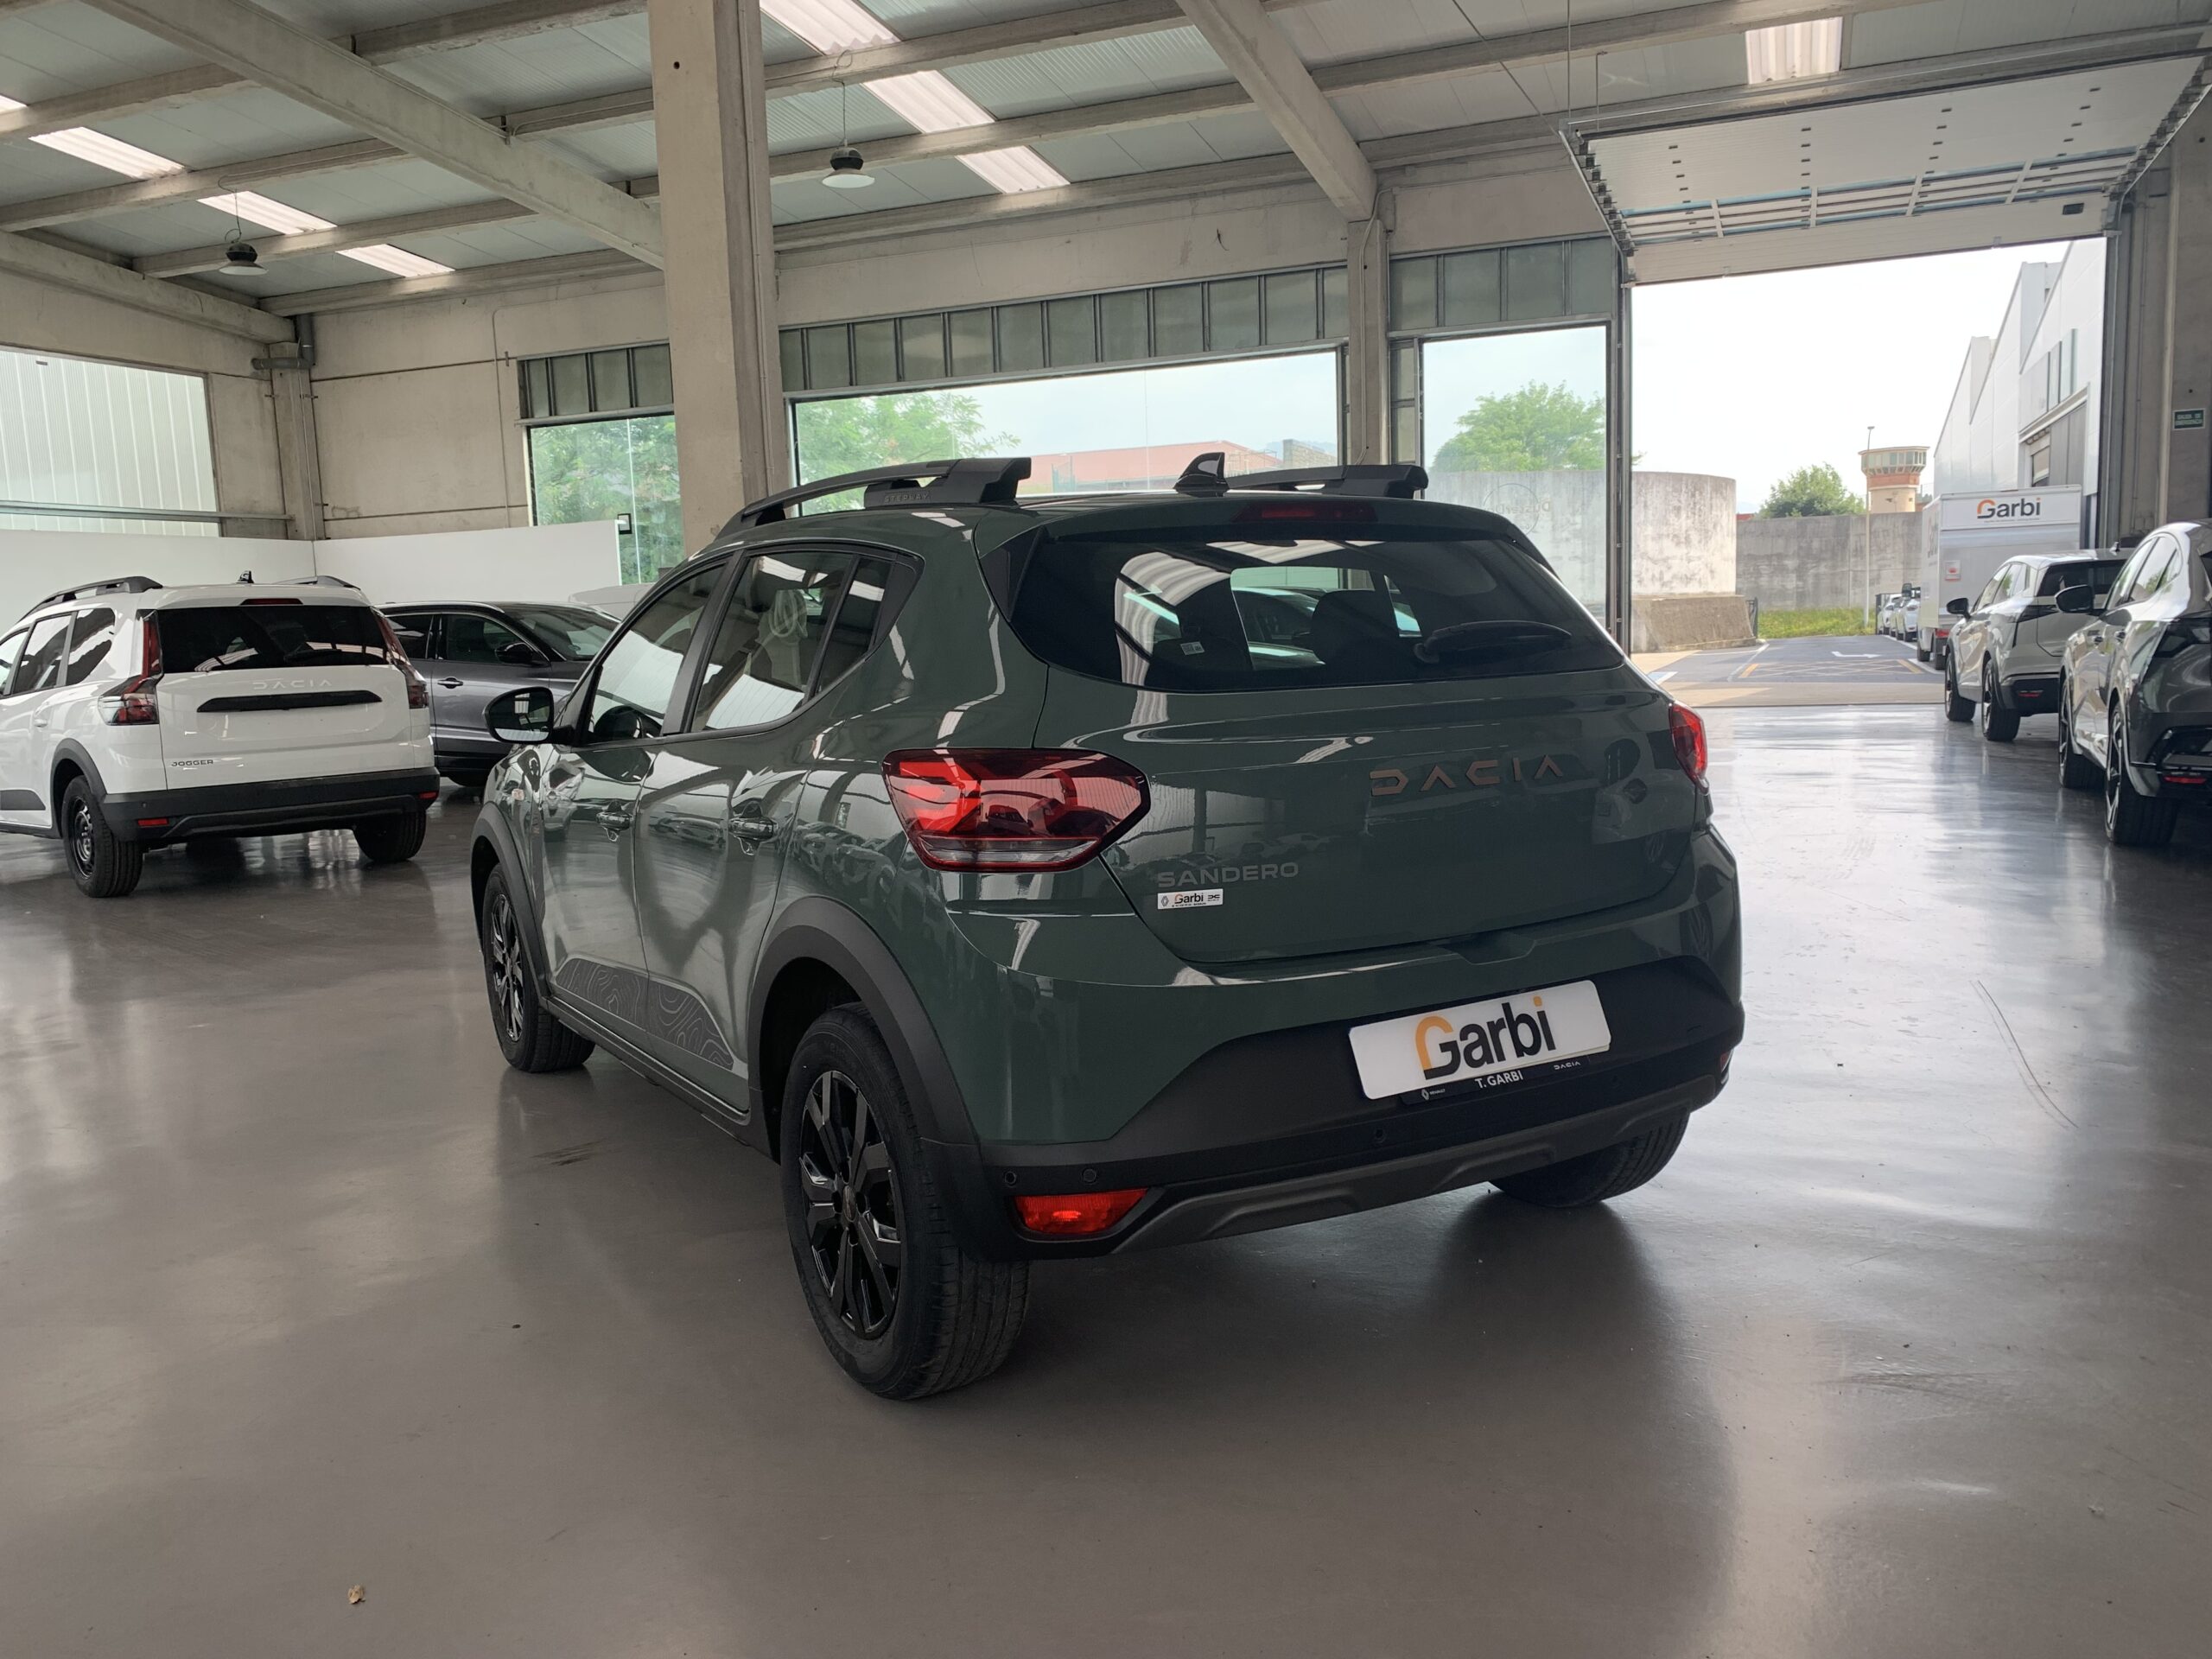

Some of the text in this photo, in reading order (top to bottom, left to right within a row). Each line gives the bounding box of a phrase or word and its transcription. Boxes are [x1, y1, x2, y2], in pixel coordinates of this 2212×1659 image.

[1976, 497, 2042, 519] Garbi
[252, 678, 333, 690] DACIA
[171, 759, 214, 767] JOGGER
[1370, 754, 1563, 796] DACIA
[1157, 861, 1299, 888] SANDERO
[1174, 893, 1205, 905] Garbi
[1414, 995, 1557, 1080] Garbi
[1474, 1069, 1524, 1089] T. GARBI
